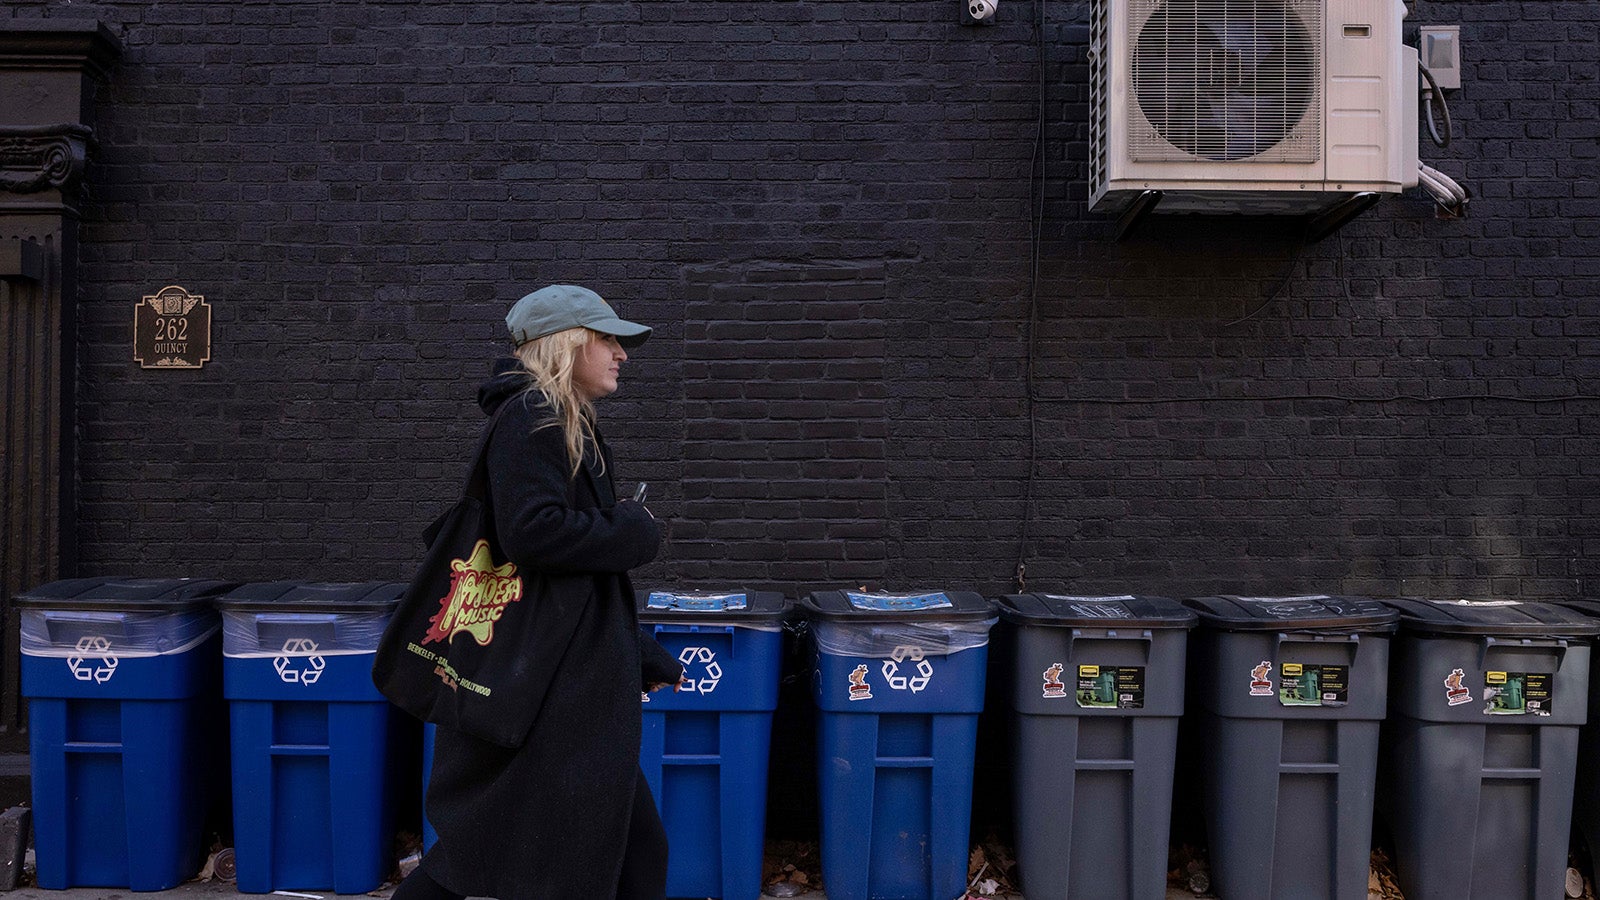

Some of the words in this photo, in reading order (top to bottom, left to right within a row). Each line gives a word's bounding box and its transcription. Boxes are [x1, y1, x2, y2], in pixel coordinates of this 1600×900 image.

[155, 318, 188, 340] 262
[154, 343, 187, 354] QUINCY
[454, 606, 504, 628] MUSIC
[407, 642, 436, 661] BERKELEY
[460, 678, 491, 697] HOLLYWOOD
